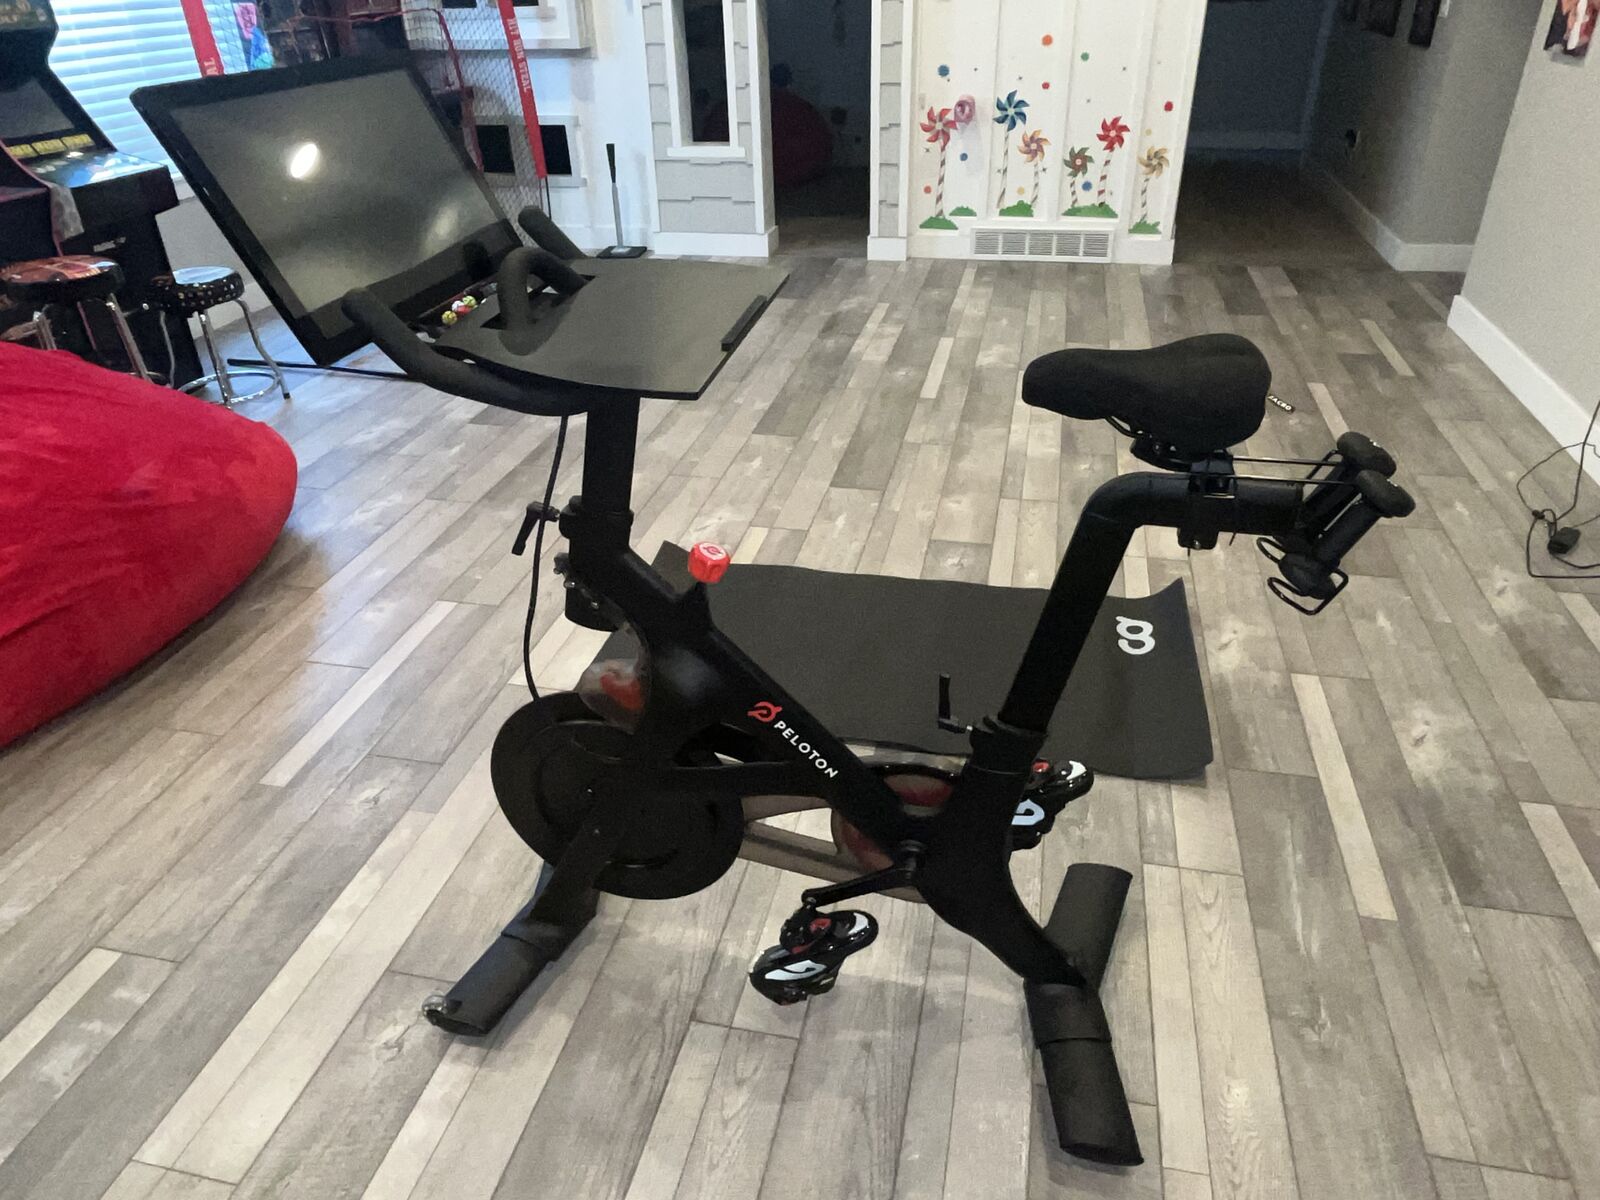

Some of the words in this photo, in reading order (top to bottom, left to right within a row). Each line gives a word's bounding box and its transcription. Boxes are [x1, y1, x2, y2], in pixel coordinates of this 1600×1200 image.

[507, 17, 518, 35] HIT
[513, 39, 525, 60] RUN
[518, 61, 531, 93] STEAL
[773, 720, 839, 779] PELOTON
